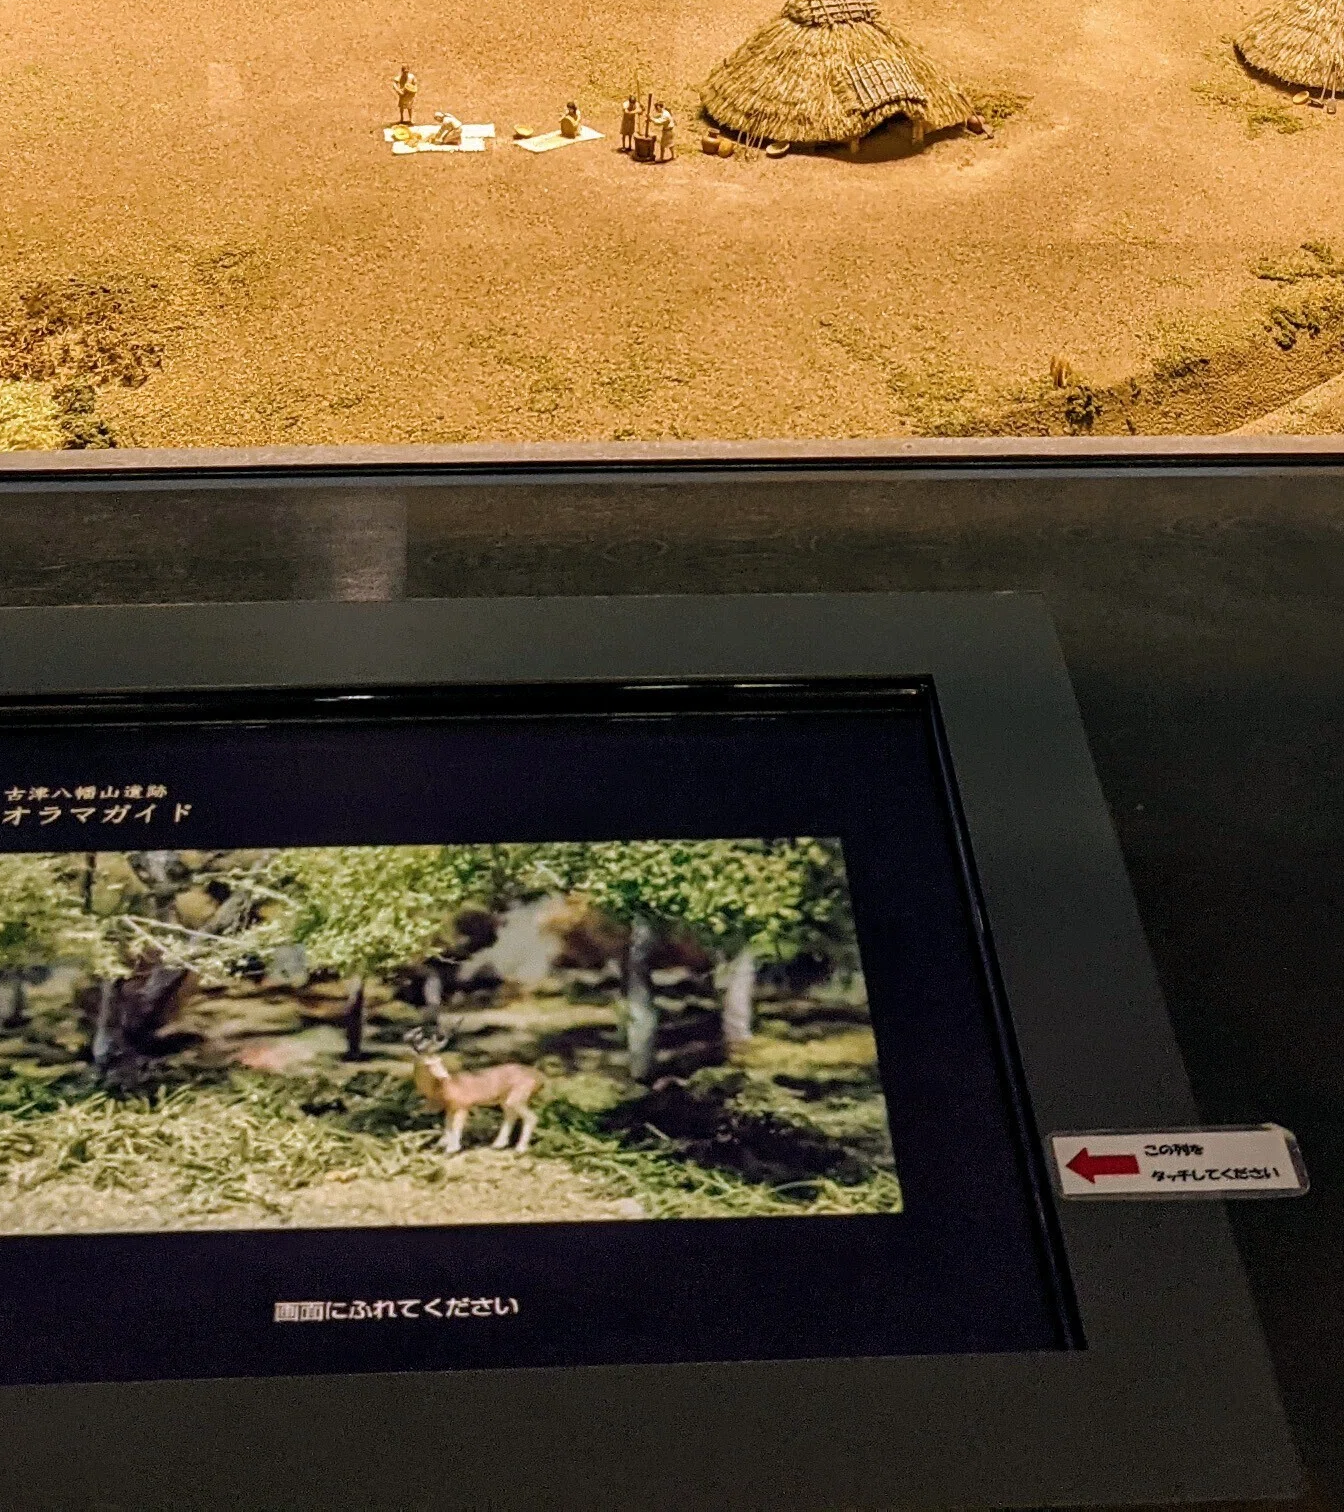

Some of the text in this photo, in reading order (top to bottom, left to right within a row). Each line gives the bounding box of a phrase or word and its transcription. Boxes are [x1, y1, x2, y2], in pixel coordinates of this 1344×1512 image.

[1151, 1166, 1281, 1182] タッチしてください
[273, 1297, 519, 1322] 画面にふれてください
